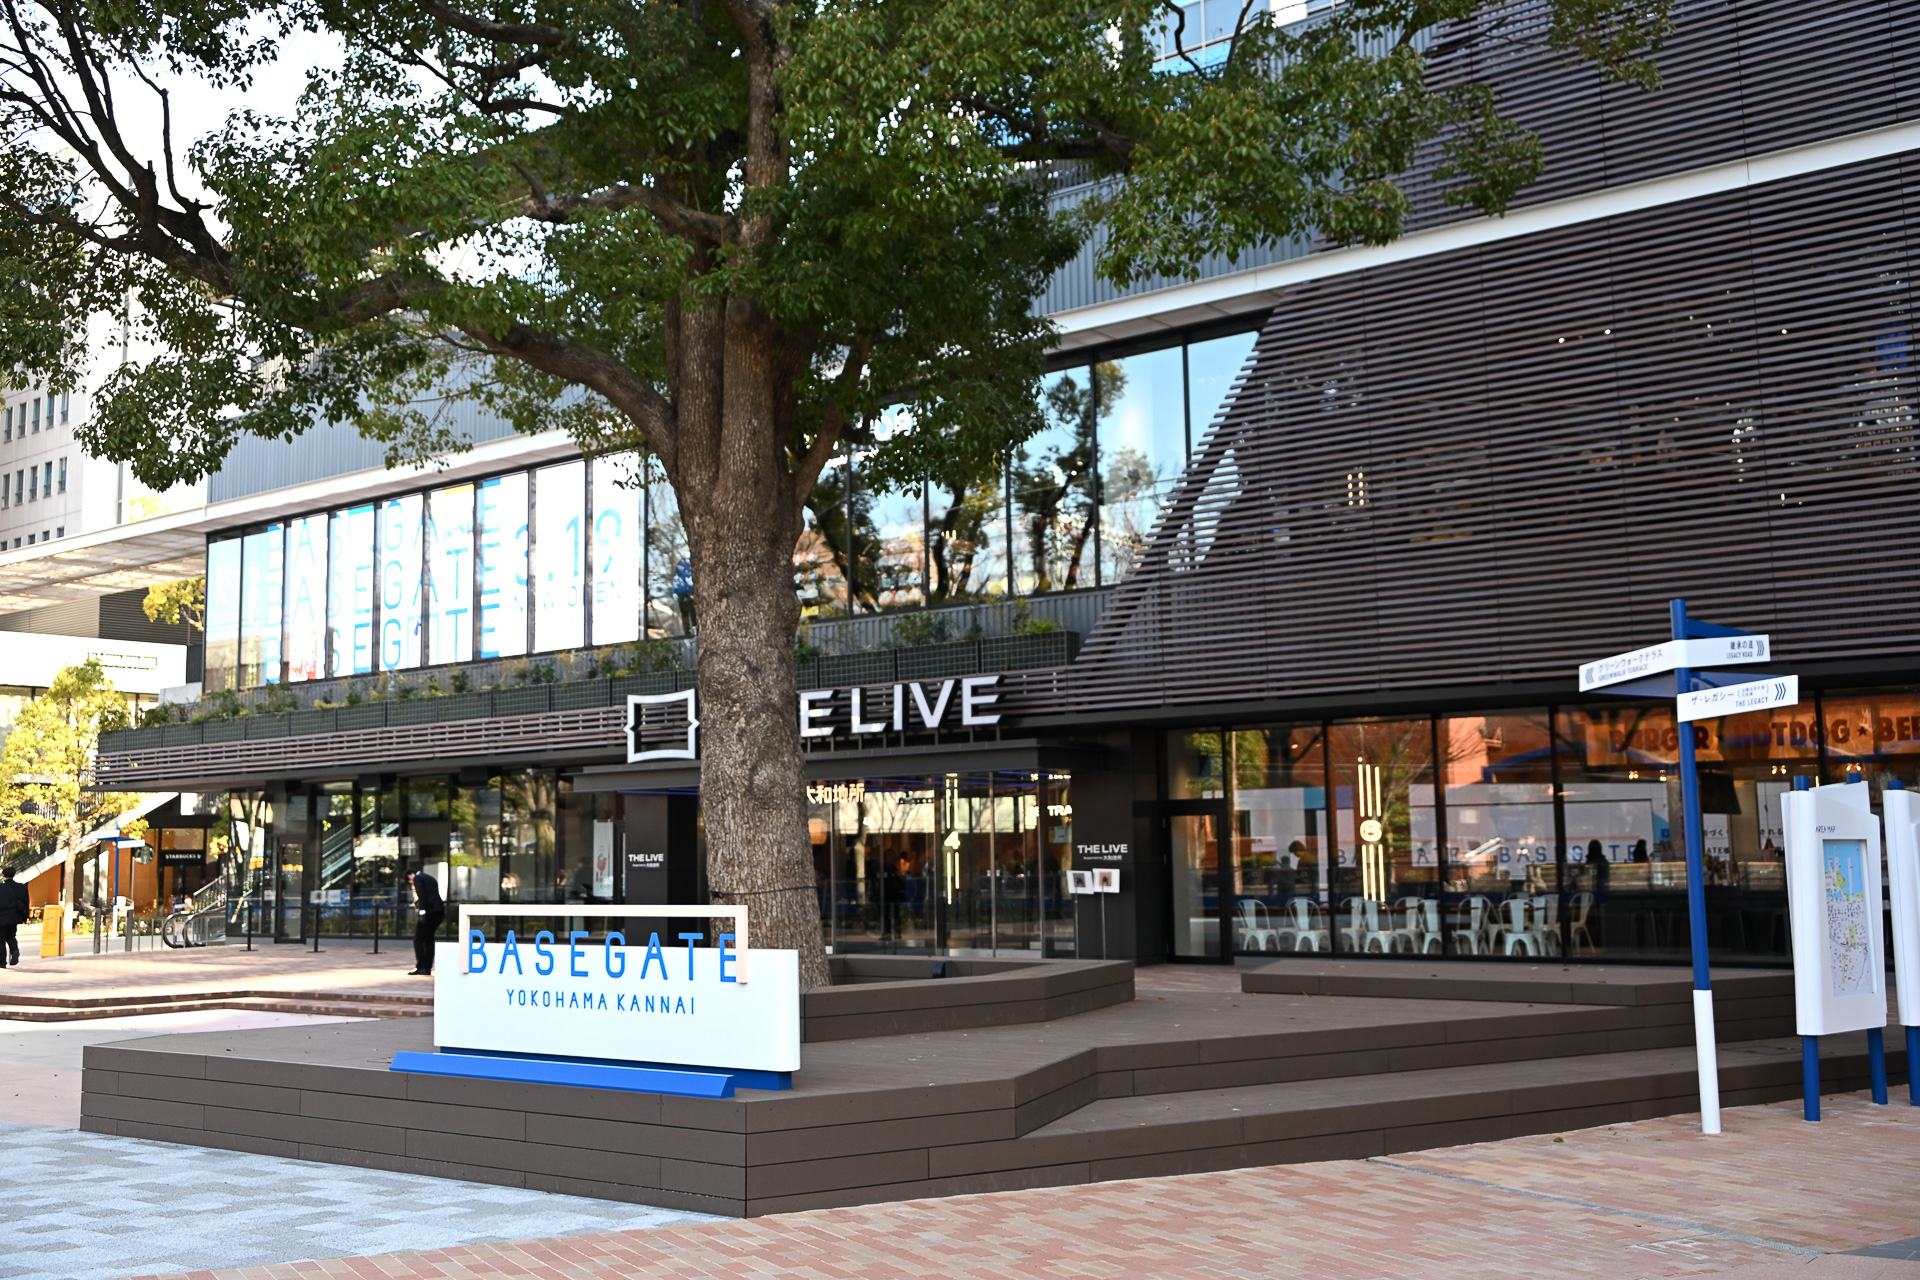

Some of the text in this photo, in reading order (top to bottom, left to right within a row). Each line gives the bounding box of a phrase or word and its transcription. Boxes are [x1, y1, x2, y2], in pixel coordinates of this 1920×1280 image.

[567, 580, 621, 607] OEN
[851, 676, 1001, 733] LIVE
[1735, 697, 1769, 708] THE LEGACY
[1360, 819, 1382, 842] 6
[628, 853, 664, 862] THE LIVE
[1077, 844, 1128, 854] THE LIVE
[1500, 844, 1637, 864] BASGTE
[468, 929, 737, 983] BASEGATE
[506, 988, 695, 1016] YOKOHAMA KANNAI
